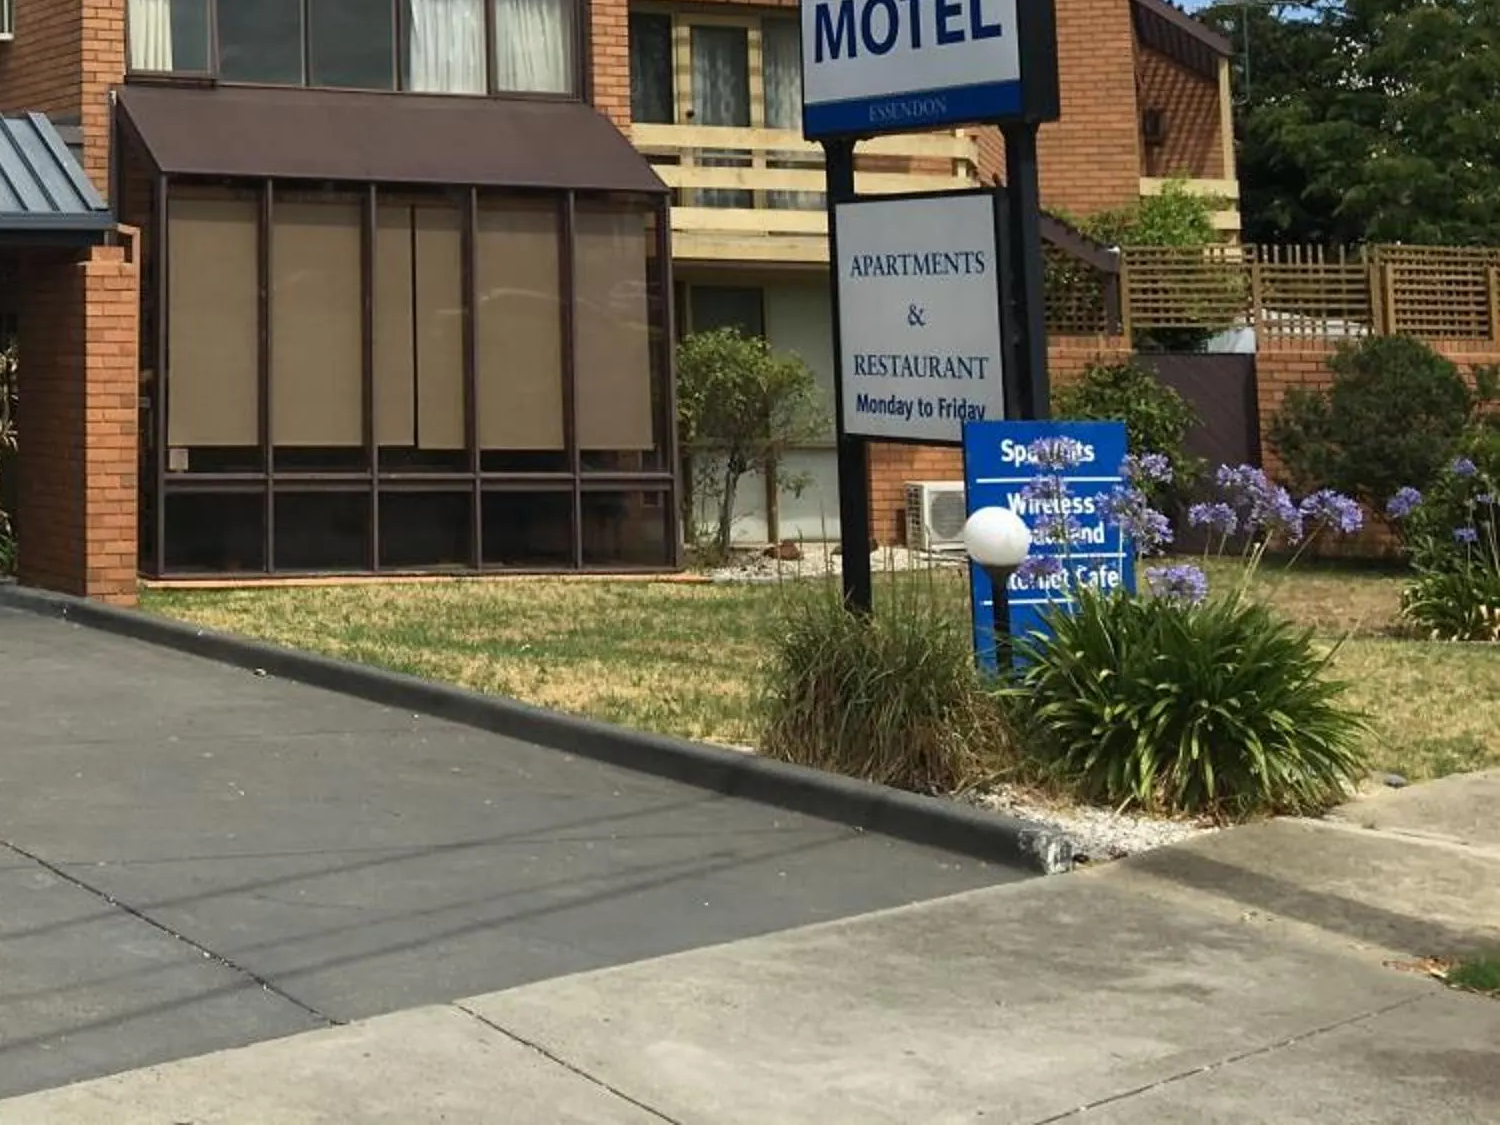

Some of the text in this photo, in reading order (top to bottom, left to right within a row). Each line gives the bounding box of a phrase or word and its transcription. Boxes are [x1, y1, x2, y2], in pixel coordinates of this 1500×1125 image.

[869, 95, 948, 122] ESSENDON
[851, 251, 986, 277] APARTMENTS
[907, 303, 926, 327] &
[854, 354, 990, 380] RESTAURANT
[856, 394, 986, 421] Monday to Friday
[1077, 564, 1120, 589] Cafe
